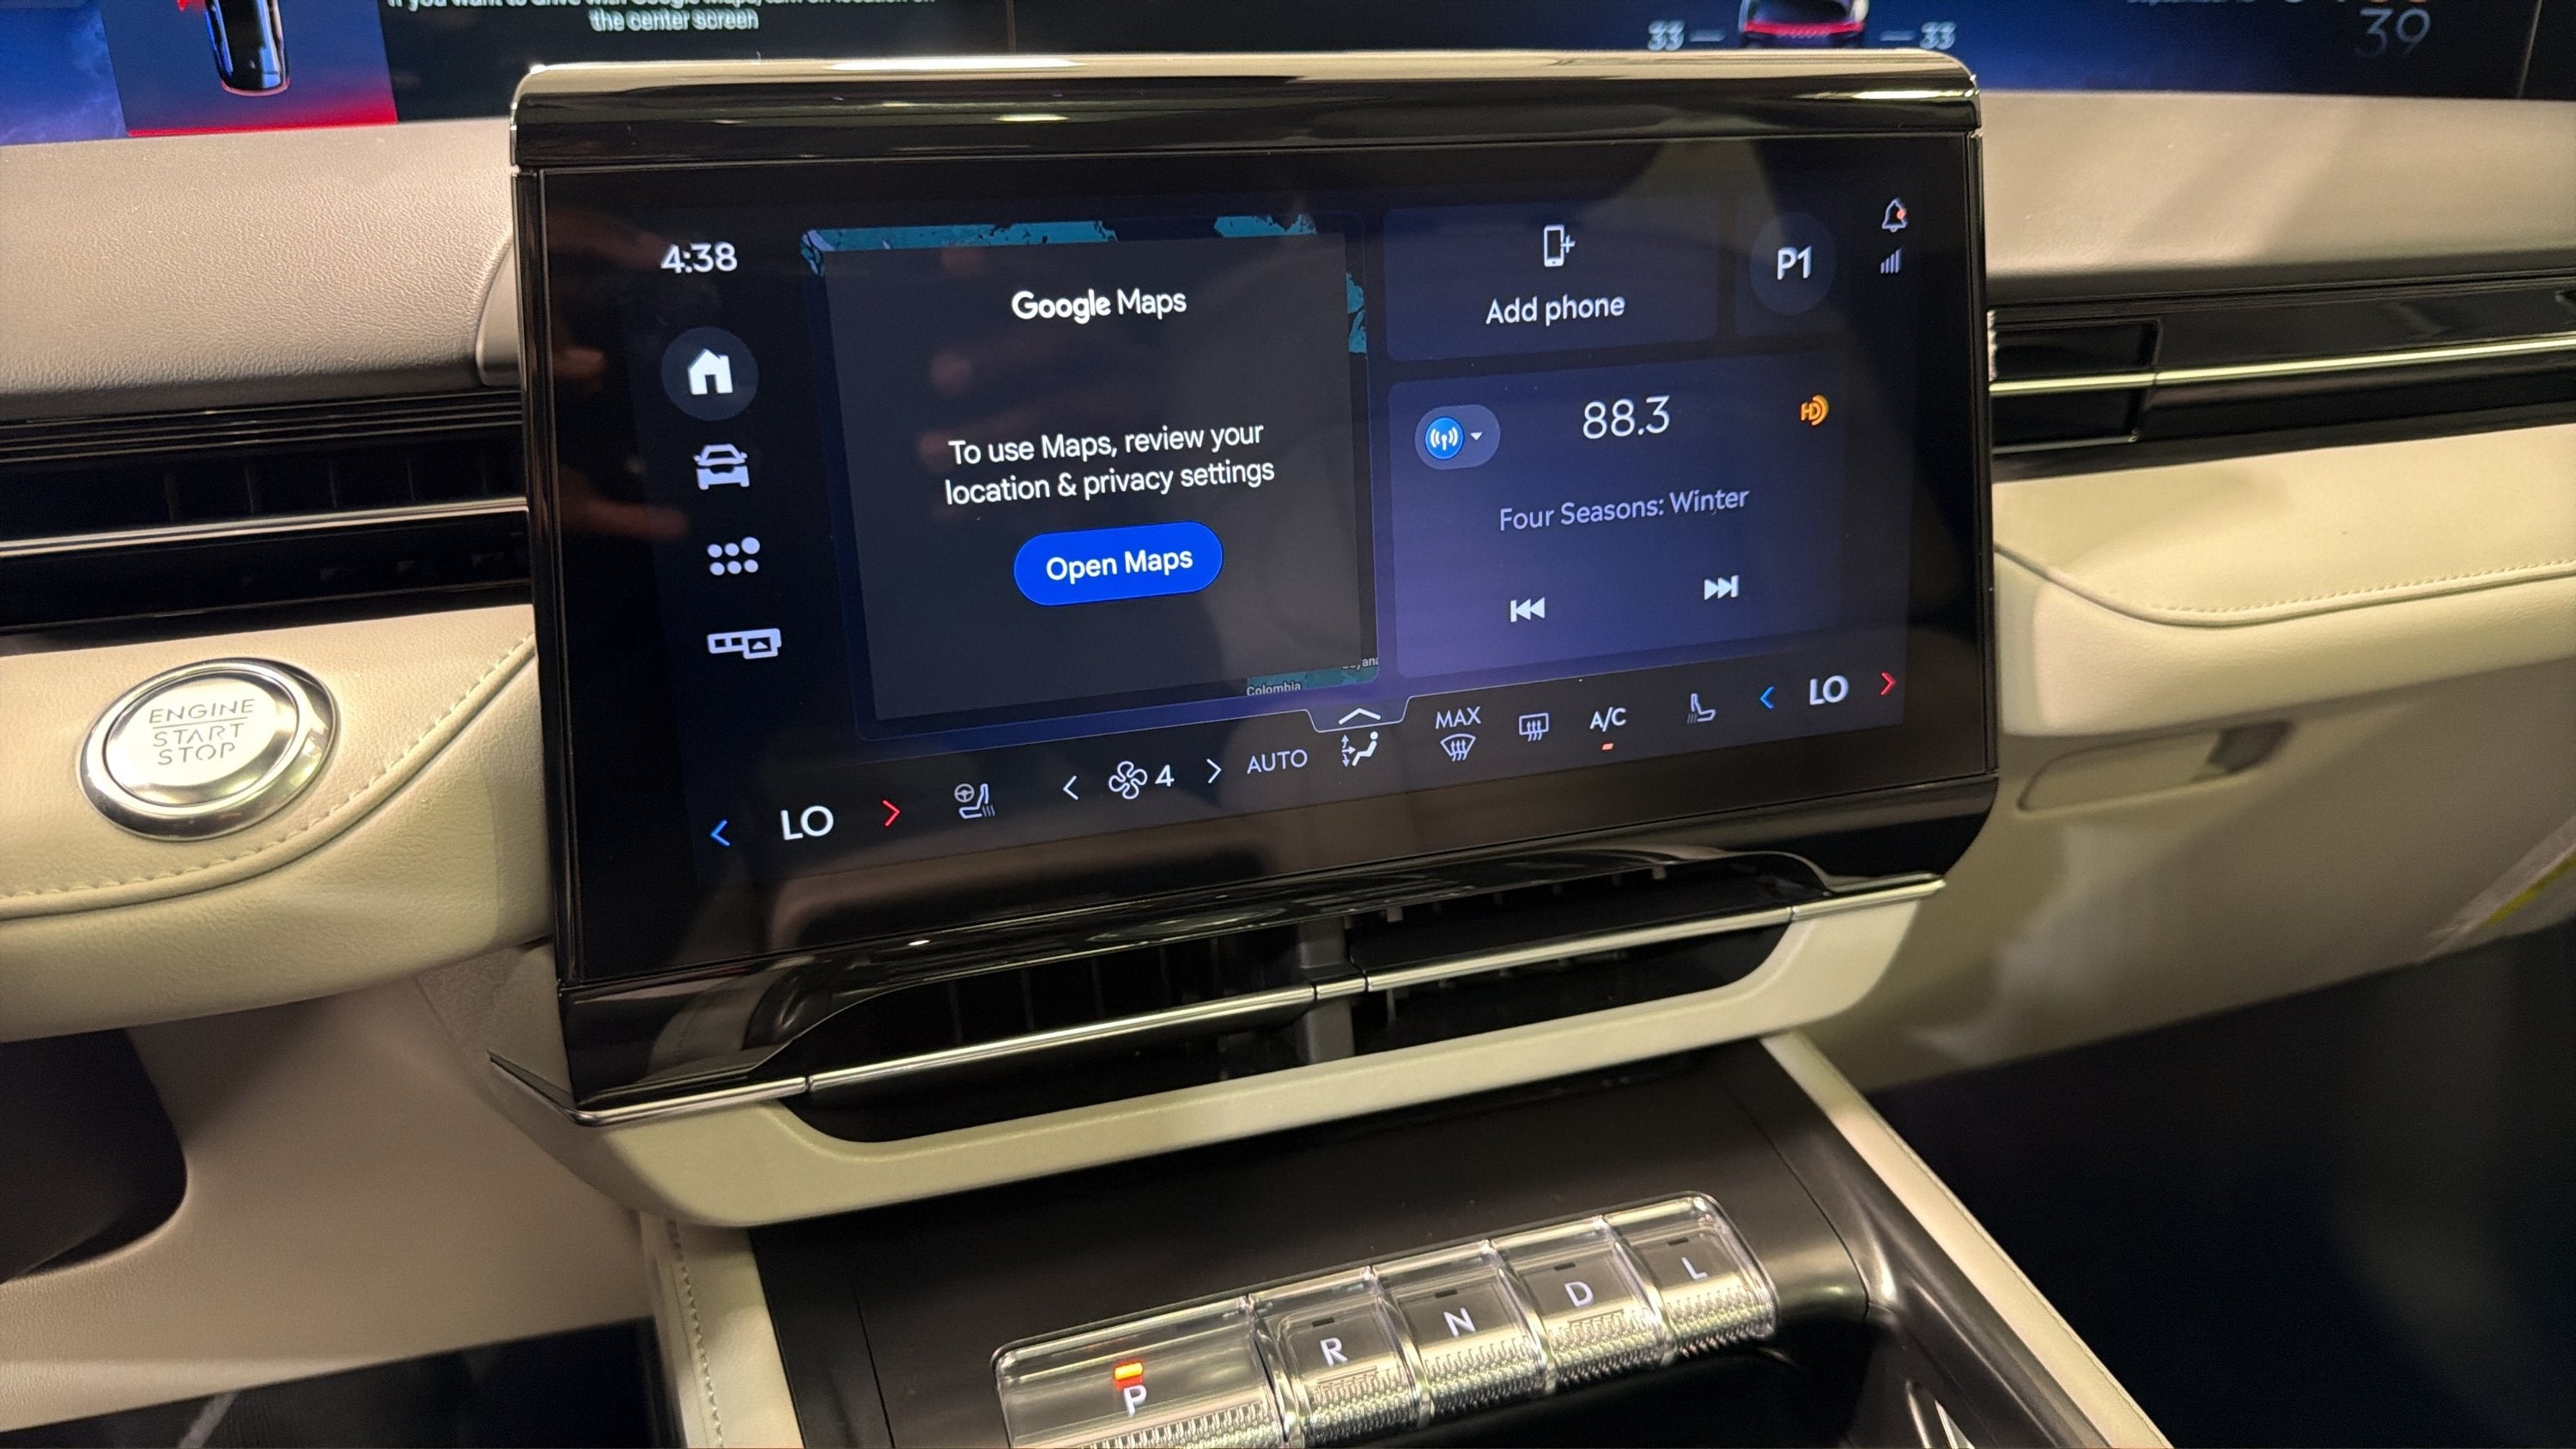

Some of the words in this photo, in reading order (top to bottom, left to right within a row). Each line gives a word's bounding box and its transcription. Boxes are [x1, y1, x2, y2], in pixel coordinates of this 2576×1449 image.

[588, 8, 625, 31] the
[626, 8, 690, 31] center
[691, 8, 760, 31] screen
[2354, 8, 2431, 58] 39
[1647, 20, 1686, 51] 33
[1919, 21, 1957, 50] 33
[660, 241, 738, 274] 4:38
[1777, 246, 1813, 280] P1
[1012, 289, 1111, 324] Google
[1117, 288, 1187, 320] Maps
[1485, 297, 1537, 325] Add
[1546, 295, 1625, 326] phone
[1583, 395, 1670, 439] 88.3
[948, 439, 981, 465] To
[988, 440, 1034, 463] use
[1041, 434, 1117, 462] Maps,
[1125, 425, 1204, 454] review
[1211, 425, 1263, 452] your
[945, 475, 1050, 505] location
[1057, 472, 1077, 496] &
[1084, 468, 1173, 501] privacy
[1181, 460, 1275, 487] settings
[1499, 508, 1554, 531] Four
[1560, 498, 1664, 526] Seasons:
[1669, 489, 1750, 514] Winter
[1046, 557, 1117, 584] Open
[1125, 550, 1194, 575] Maps
[1809, 676, 1850, 705] LO
[149, 699, 255, 724] ENGINE
[1436, 706, 1482, 729] MAX
[1589, 706, 1627, 732] A/C
[154, 723, 244, 747] START
[158, 742, 236, 765] STOP
[1247, 749, 1309, 775] AUTO
[1155, 764, 1176, 788] 4
[781, 805, 835, 841] LO
[1680, 1257, 1709, 1281] L
[1564, 1281, 1595, 1307] D
[1443, 1306, 1475, 1336] N
[1319, 1336, 1348, 1367] R
[1123, 1385, 1147, 1416] P
